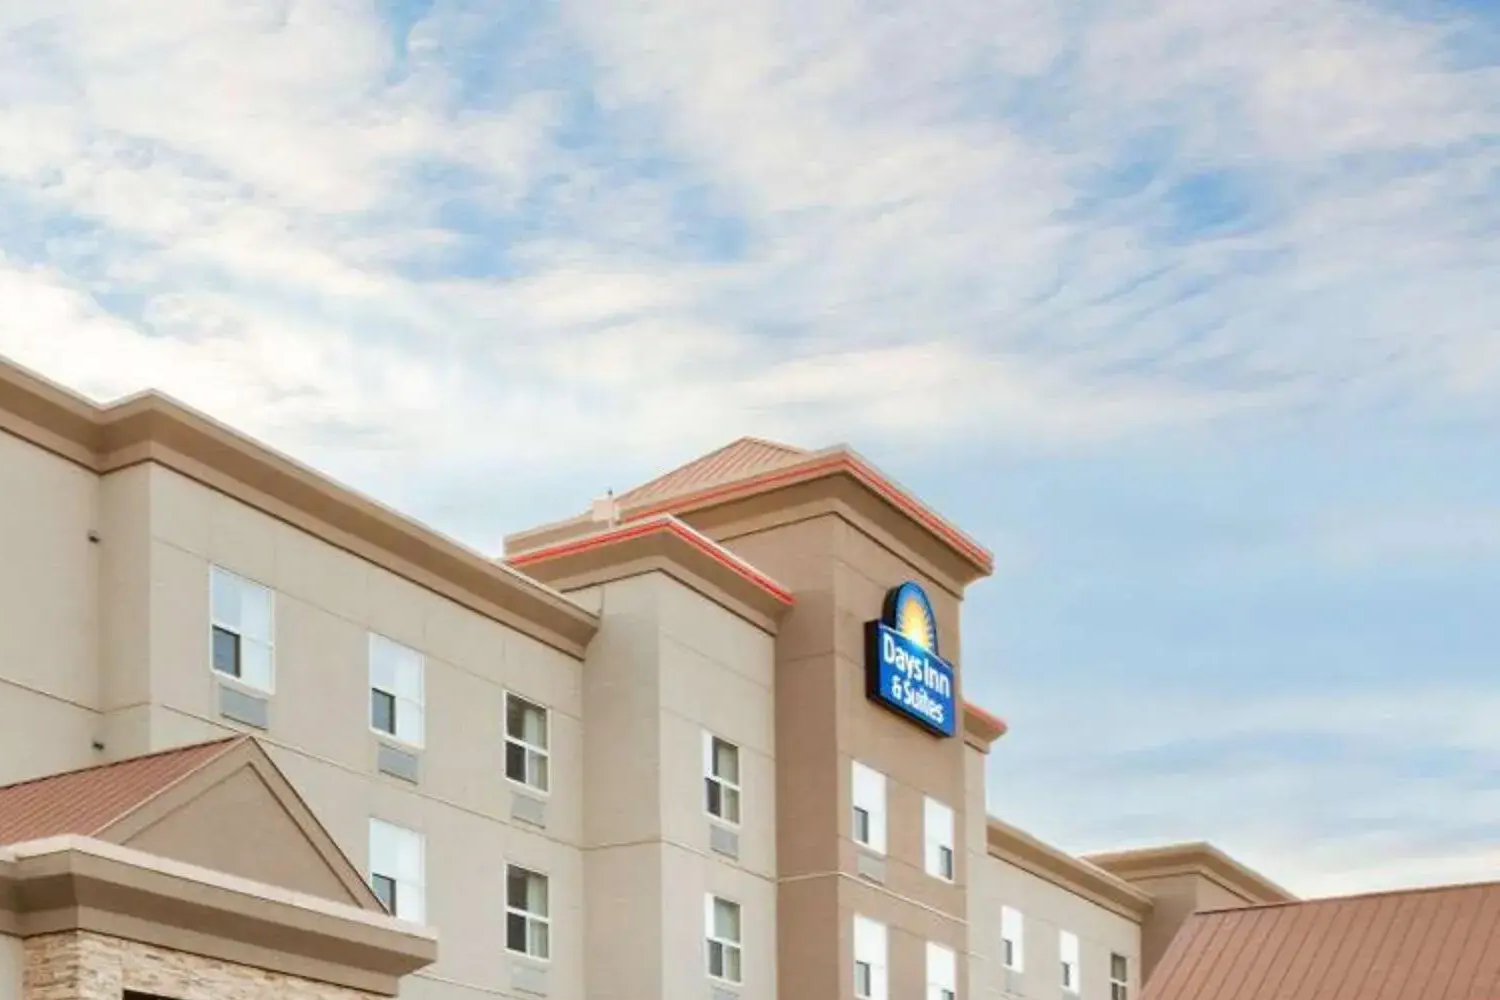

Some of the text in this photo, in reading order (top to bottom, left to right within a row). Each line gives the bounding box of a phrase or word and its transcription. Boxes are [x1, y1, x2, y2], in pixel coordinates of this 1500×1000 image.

[883, 632, 950, 698] Days Inn
[903, 680, 945, 723] Suites
